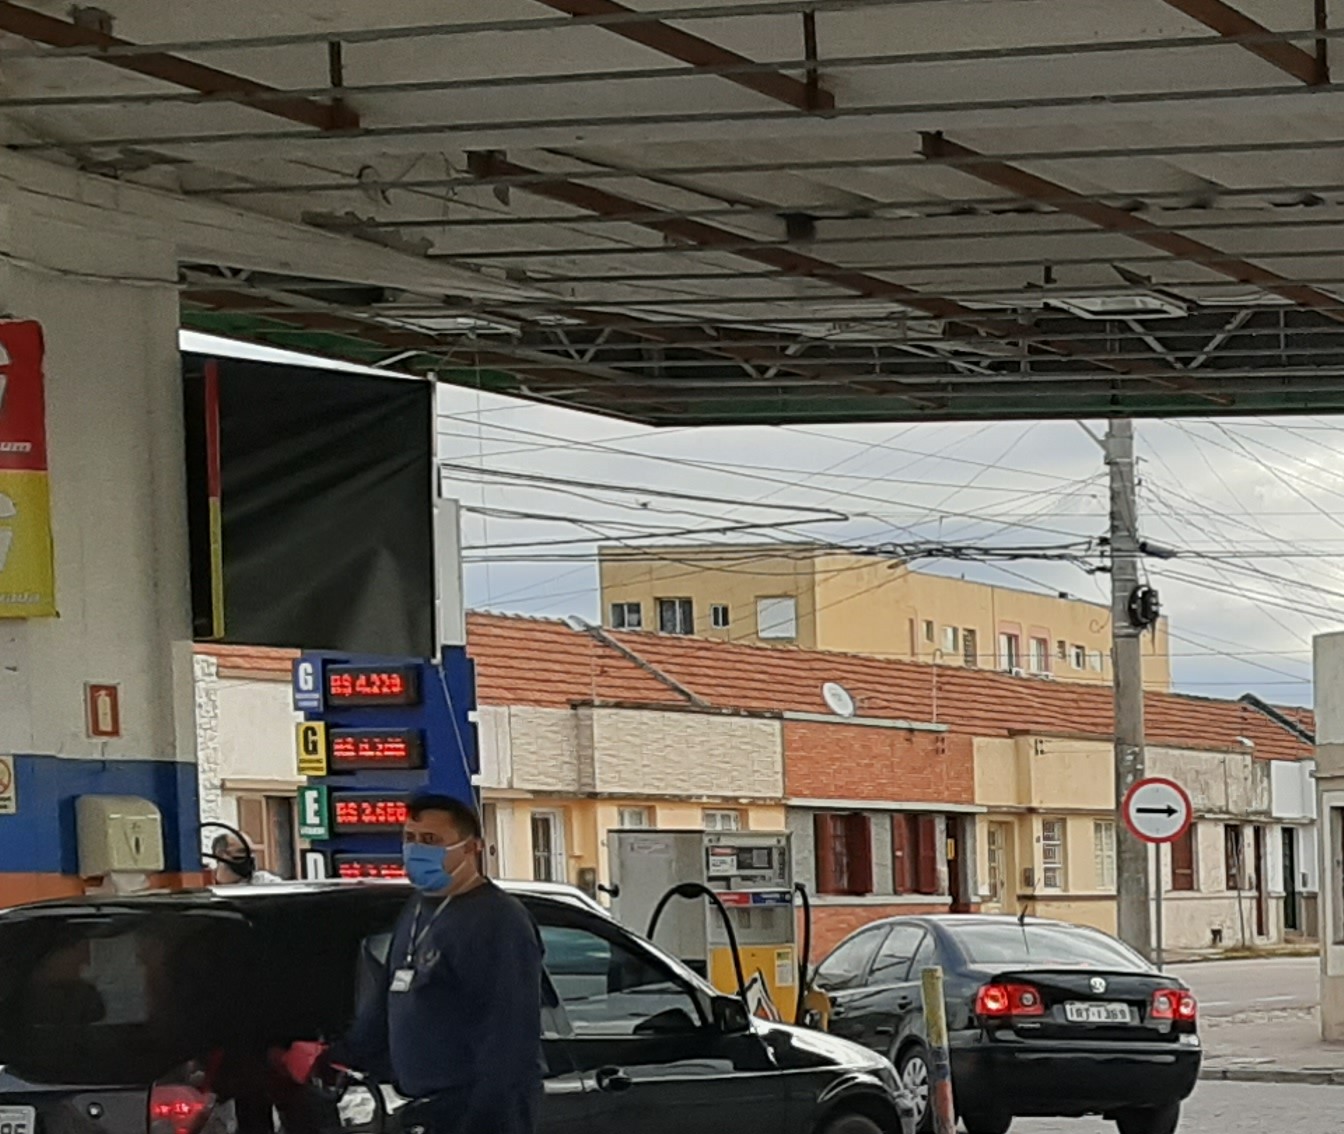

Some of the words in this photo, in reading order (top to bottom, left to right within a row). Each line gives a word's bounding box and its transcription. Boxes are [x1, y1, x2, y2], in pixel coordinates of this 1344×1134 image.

[298, 662, 313, 691] G
[302, 726, 318, 755] G
[304, 790, 320, 824] E
